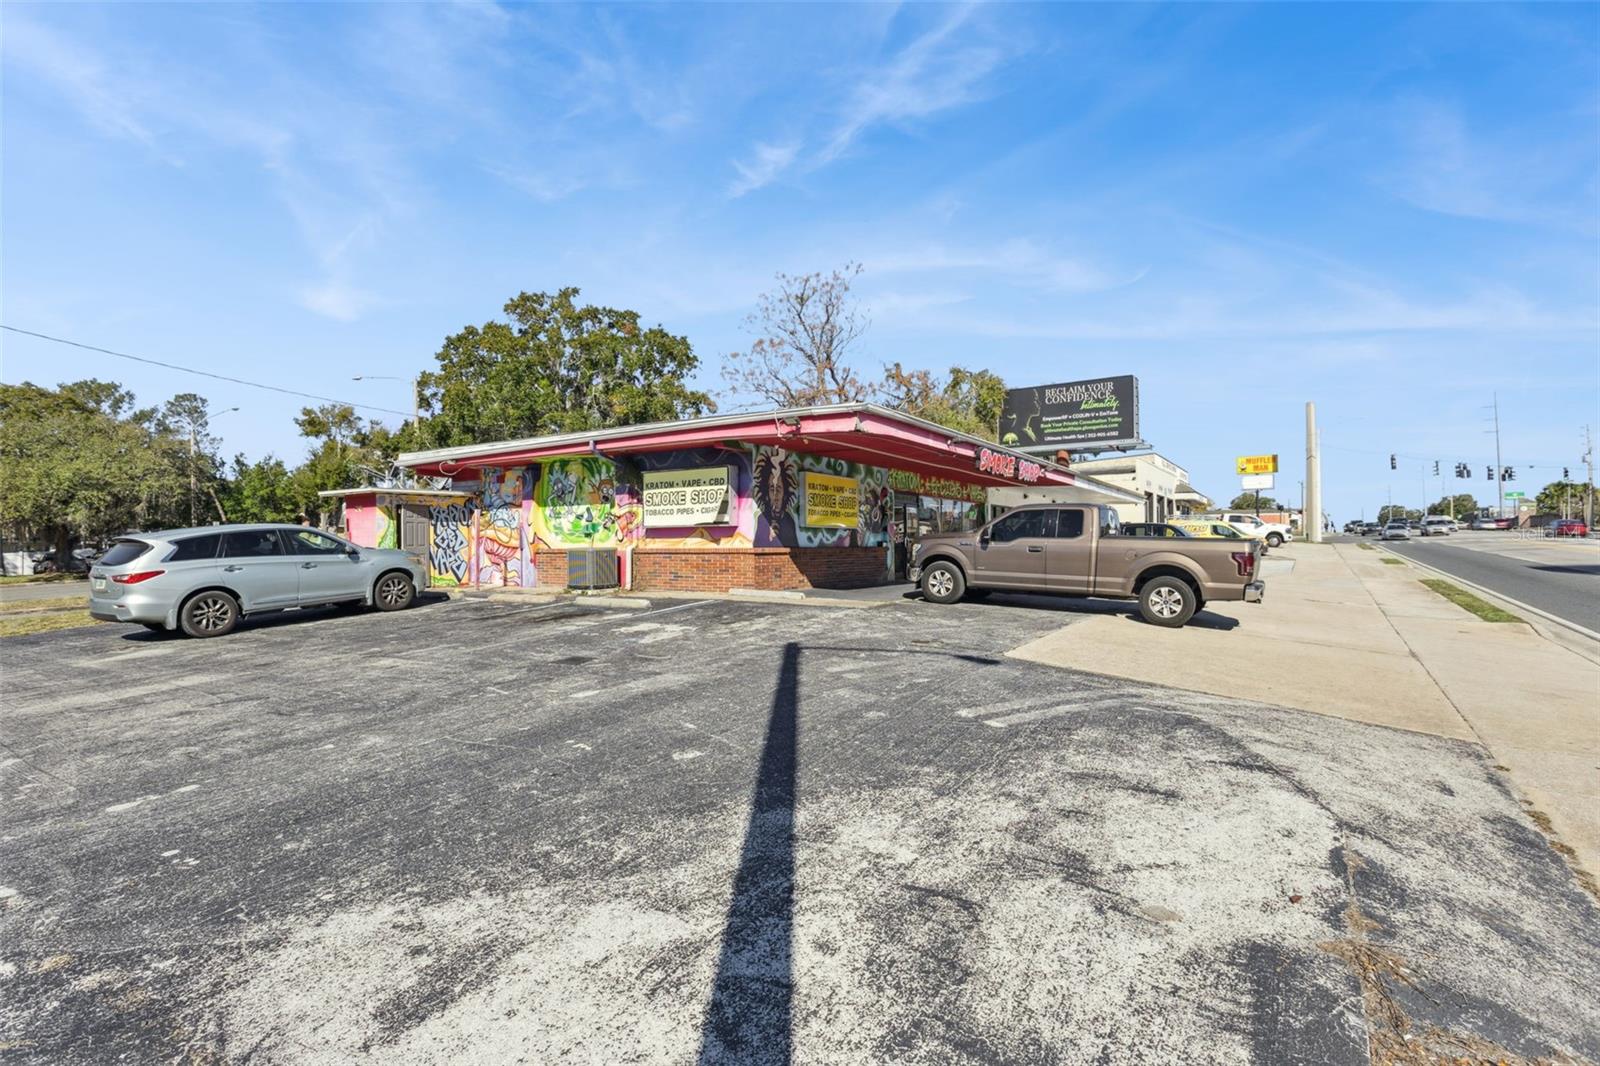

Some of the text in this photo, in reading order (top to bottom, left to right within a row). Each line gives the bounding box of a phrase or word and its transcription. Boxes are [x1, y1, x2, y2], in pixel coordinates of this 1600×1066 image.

[1045, 381, 1114, 398] RECLAIM YOUR
[980, 448, 1041, 482] SMOKE SHOP
[1245, 456, 1277, 464] MUFFLER
[1253, 464, 1269, 472] MAN
[646, 477, 725, 489] KRATOM VAPE CBD
[645, 488, 725, 507] SMOKE SHOP
[808, 493, 857, 509] SMOKE SHOP
[645, 508, 675, 516] TOBACCO
[676, 507, 695, 515] PIPES
